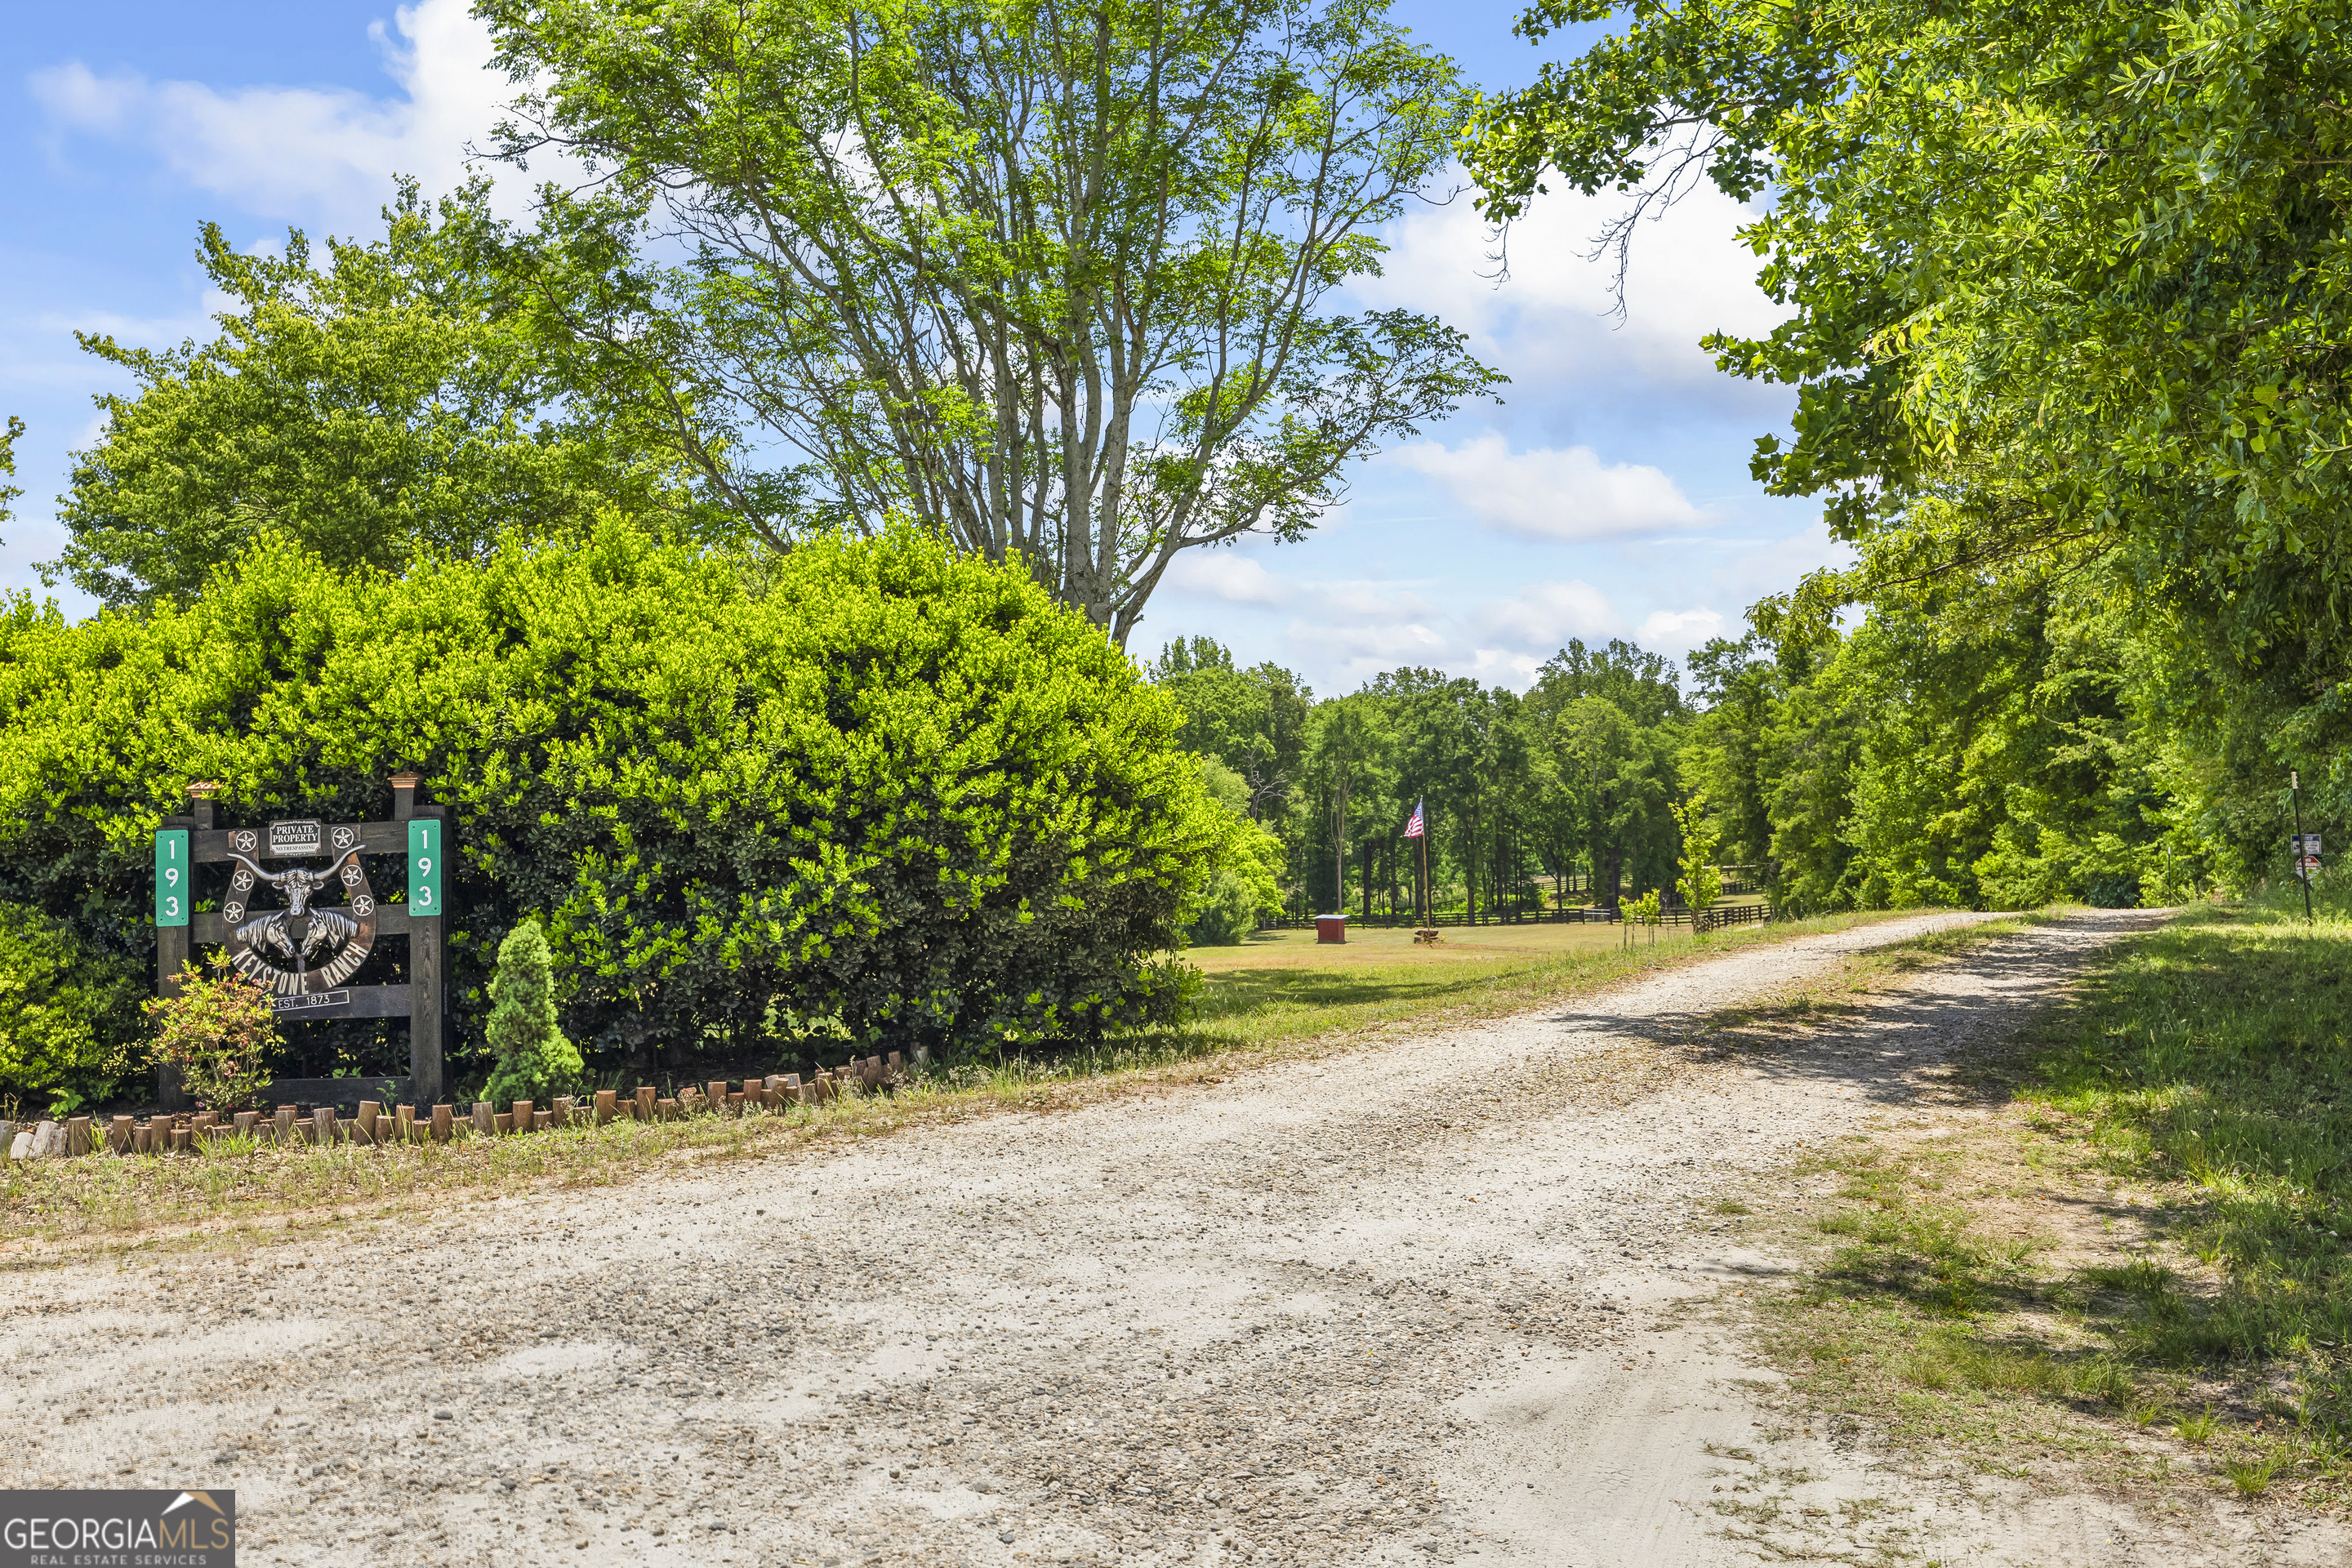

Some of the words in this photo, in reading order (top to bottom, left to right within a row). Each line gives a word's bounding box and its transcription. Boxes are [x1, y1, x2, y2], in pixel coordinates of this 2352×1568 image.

[273, 833, 317, 843] PROPERTY
[277, 825, 314, 834] PRIVATE
[164, 840, 180, 917] 193
[417, 829, 433, 906] 193
[232, 947, 310, 996] KEYSTONE
[320, 941, 369, 988] RANCH
[278, 998, 299, 1009] EST.
[306, 995, 331, 1006] 1873
